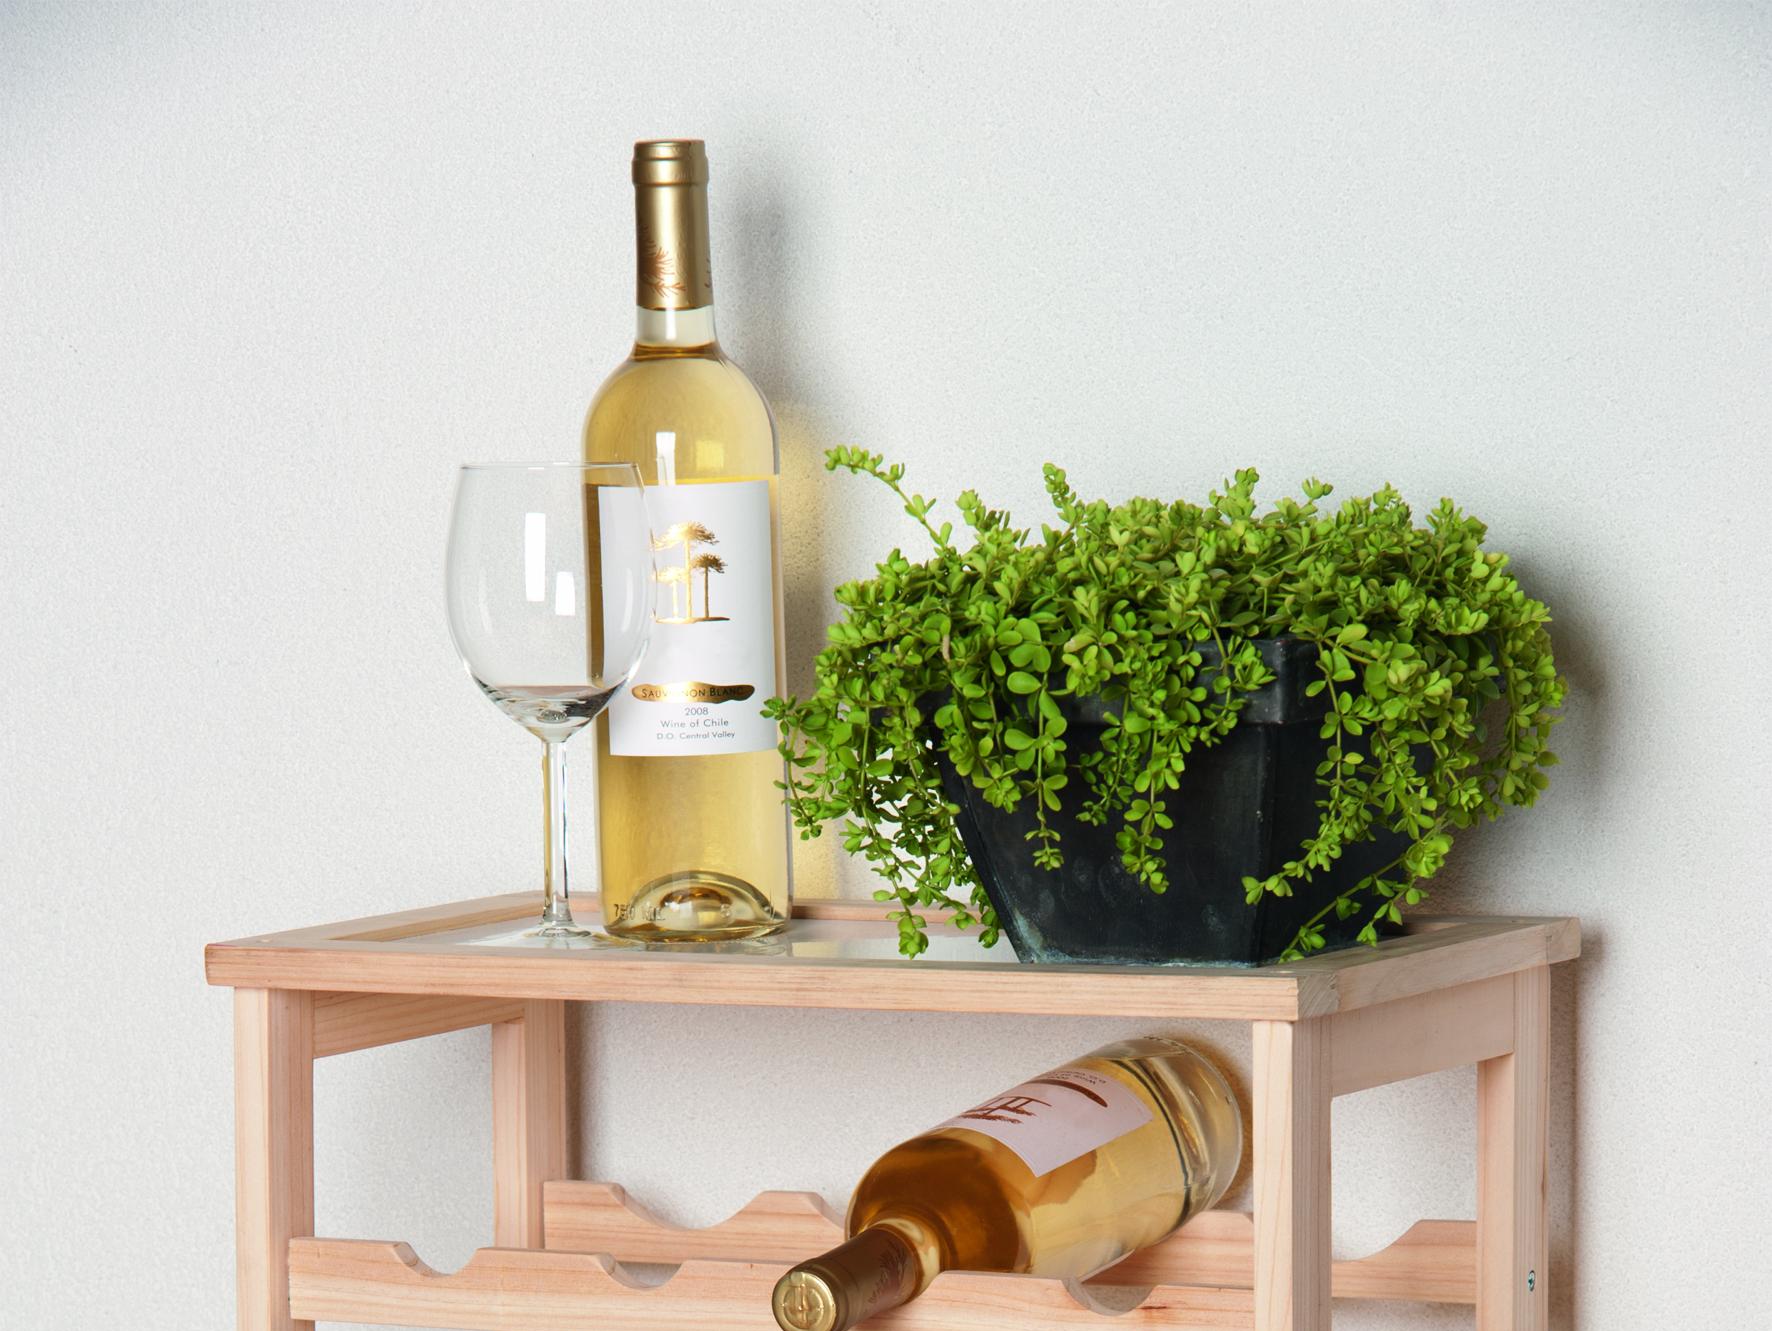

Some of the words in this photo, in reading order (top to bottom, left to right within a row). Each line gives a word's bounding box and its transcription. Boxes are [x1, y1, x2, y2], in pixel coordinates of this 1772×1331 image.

[684, 706, 709, 716] 2008
[660, 721, 687, 729] Wine
[690, 719, 700, 728] of
[703, 718, 729, 727] Chile
[679, 731, 710, 740] Central
[711, 730, 735, 739] Valley
